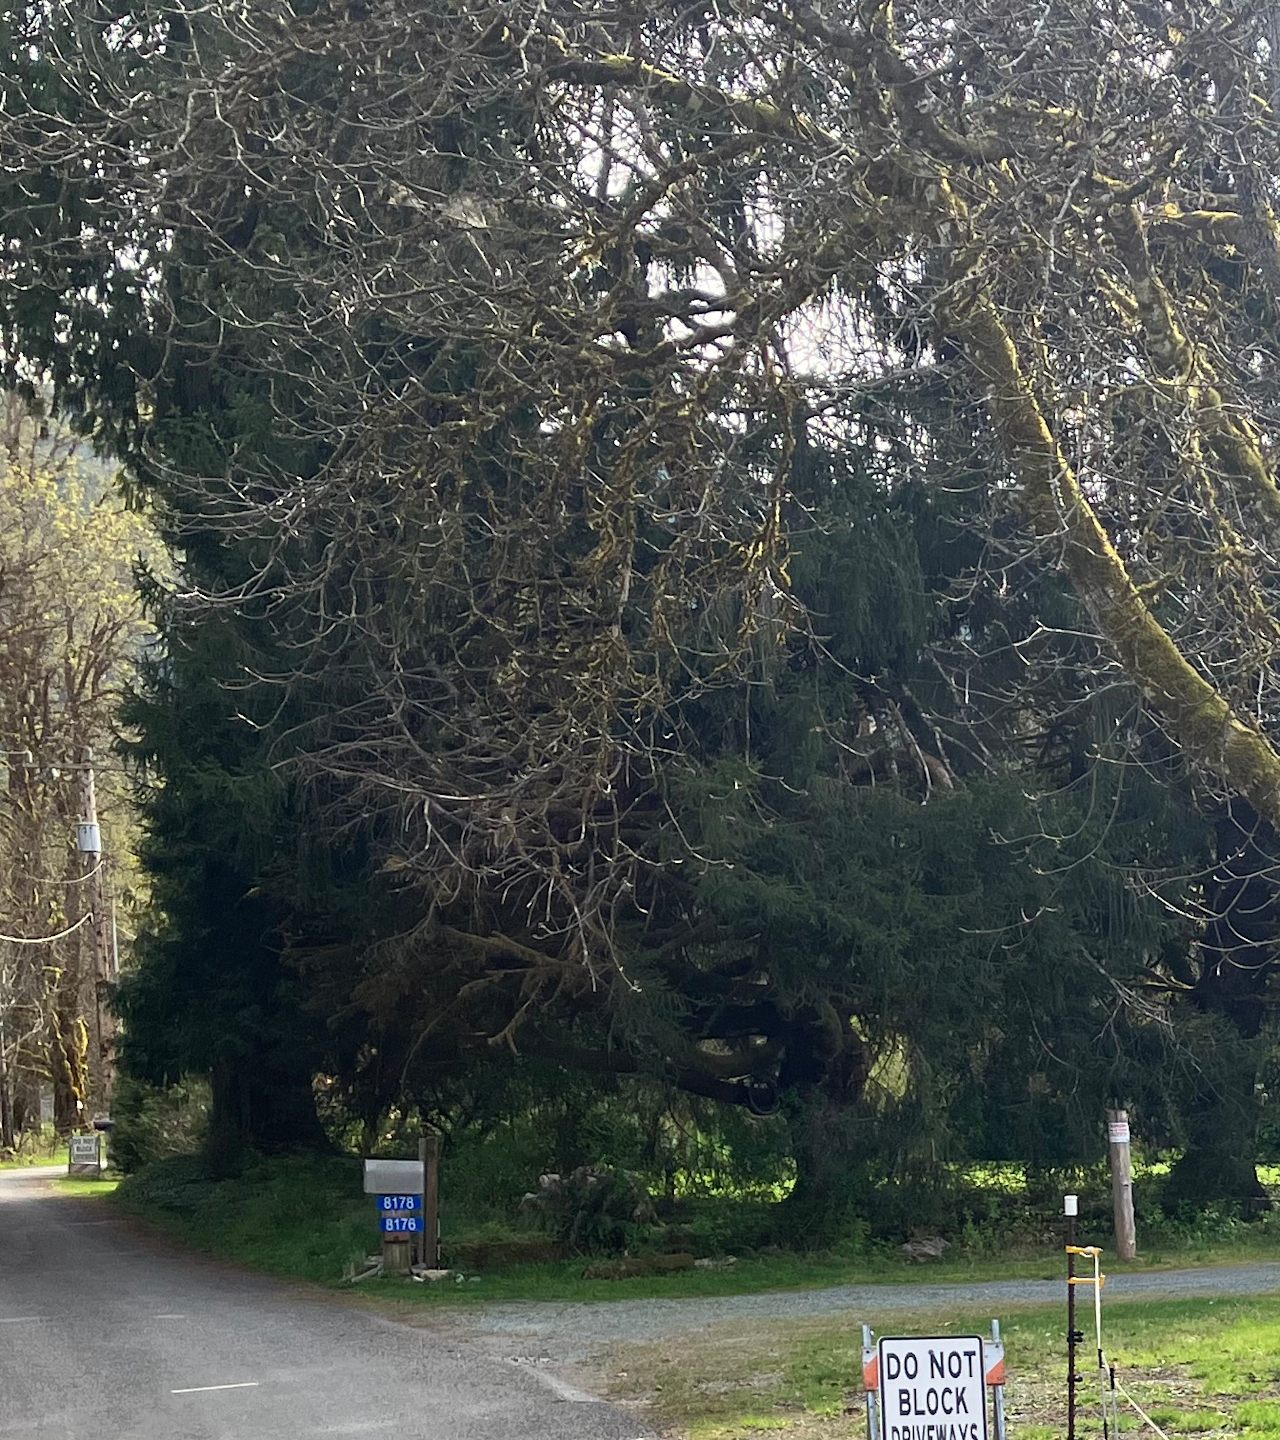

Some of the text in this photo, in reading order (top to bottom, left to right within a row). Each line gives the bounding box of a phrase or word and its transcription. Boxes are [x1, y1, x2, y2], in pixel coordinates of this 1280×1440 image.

[384, 1196, 414, 1209] 8178
[386, 1218, 416, 1231] 8176
[886, 1350, 976, 1380] DO NOT
[899, 1387, 969, 1416] BLOCK
